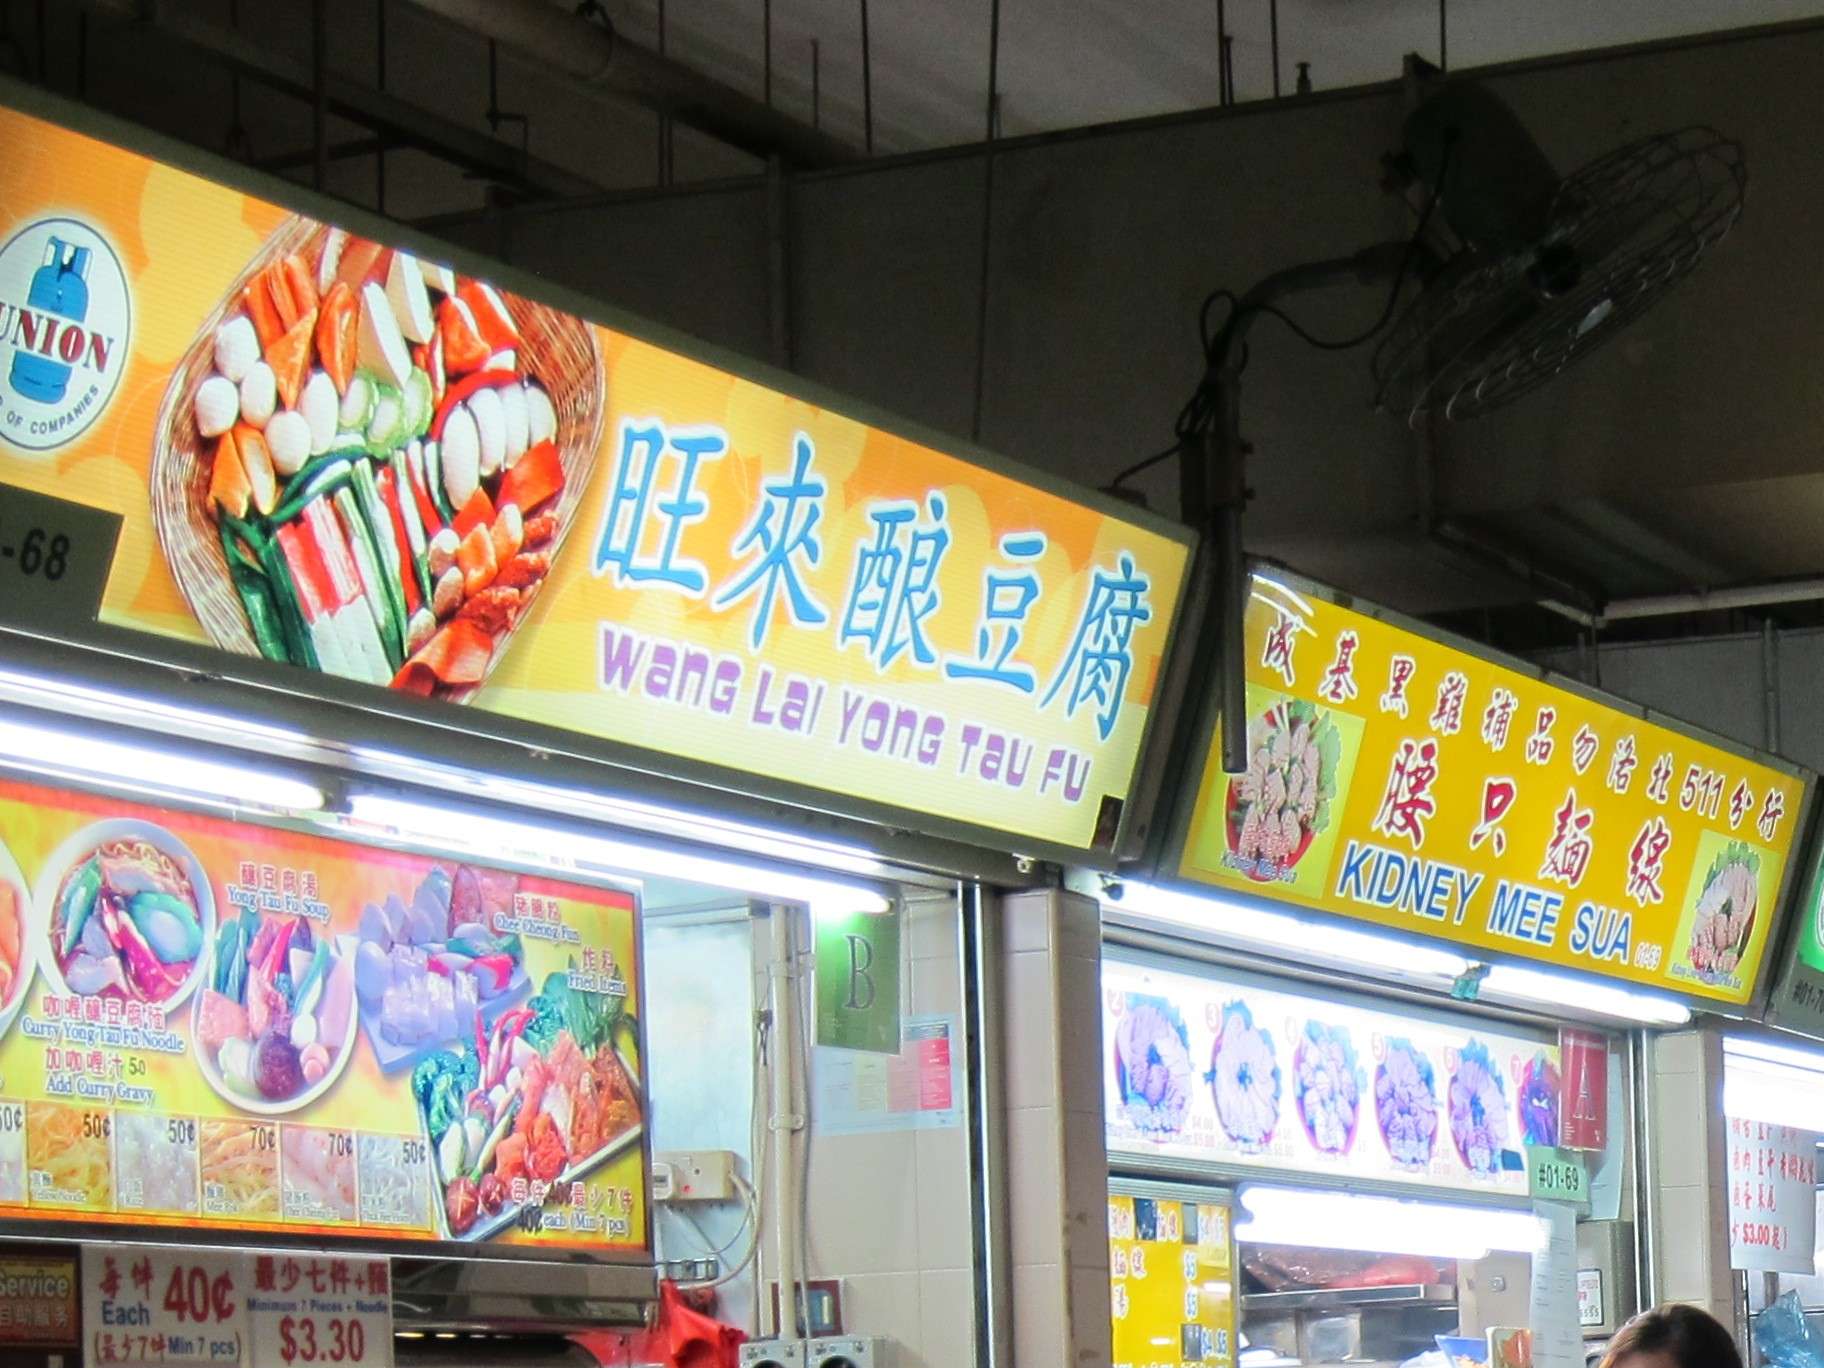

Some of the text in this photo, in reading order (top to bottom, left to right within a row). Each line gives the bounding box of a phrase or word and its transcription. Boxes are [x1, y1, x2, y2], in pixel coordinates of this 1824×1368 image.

[7, 384, 99, 434] OF COMPANIES
[227, 885, 330, 923] Yong Tau Fu Soup
[1337, 843, 1481, 923] KIDNEY
[1489, 884, 1562, 945] MEE
[1570, 904, 1633, 962] SUA
[494, 913, 581, 944] Chee Cheong Fun
[842, 933, 877, 1010] B
[22, 1017, 185, 1052] Curry Yong Tau Fu Noodle
[46, 1075, 154, 1107] Add Curry Gravy
[82, 1112, 111, 1140] 50¢
[168, 1119, 195, 1145] 50¢
[250, 1126, 276, 1151] 70¢
[329, 1133, 353, 1157] 70¢
[403, 1140, 427, 1165] 50¢
[1538, 1166, 1580, 1193] #01-69
[163, 1264, 235, 1324] 40¢
[247, 1297, 298, 1312] Minimum
[310, 1299, 342, 1313] Pieces
[356, 1299, 388, 1314] Noodle
[102, 1300, 150, 1326] Each
[168, 1336, 193, 1355] Min
[198, 1336, 205, 1355] 7
[279, 1315, 365, 1366] $3.30
